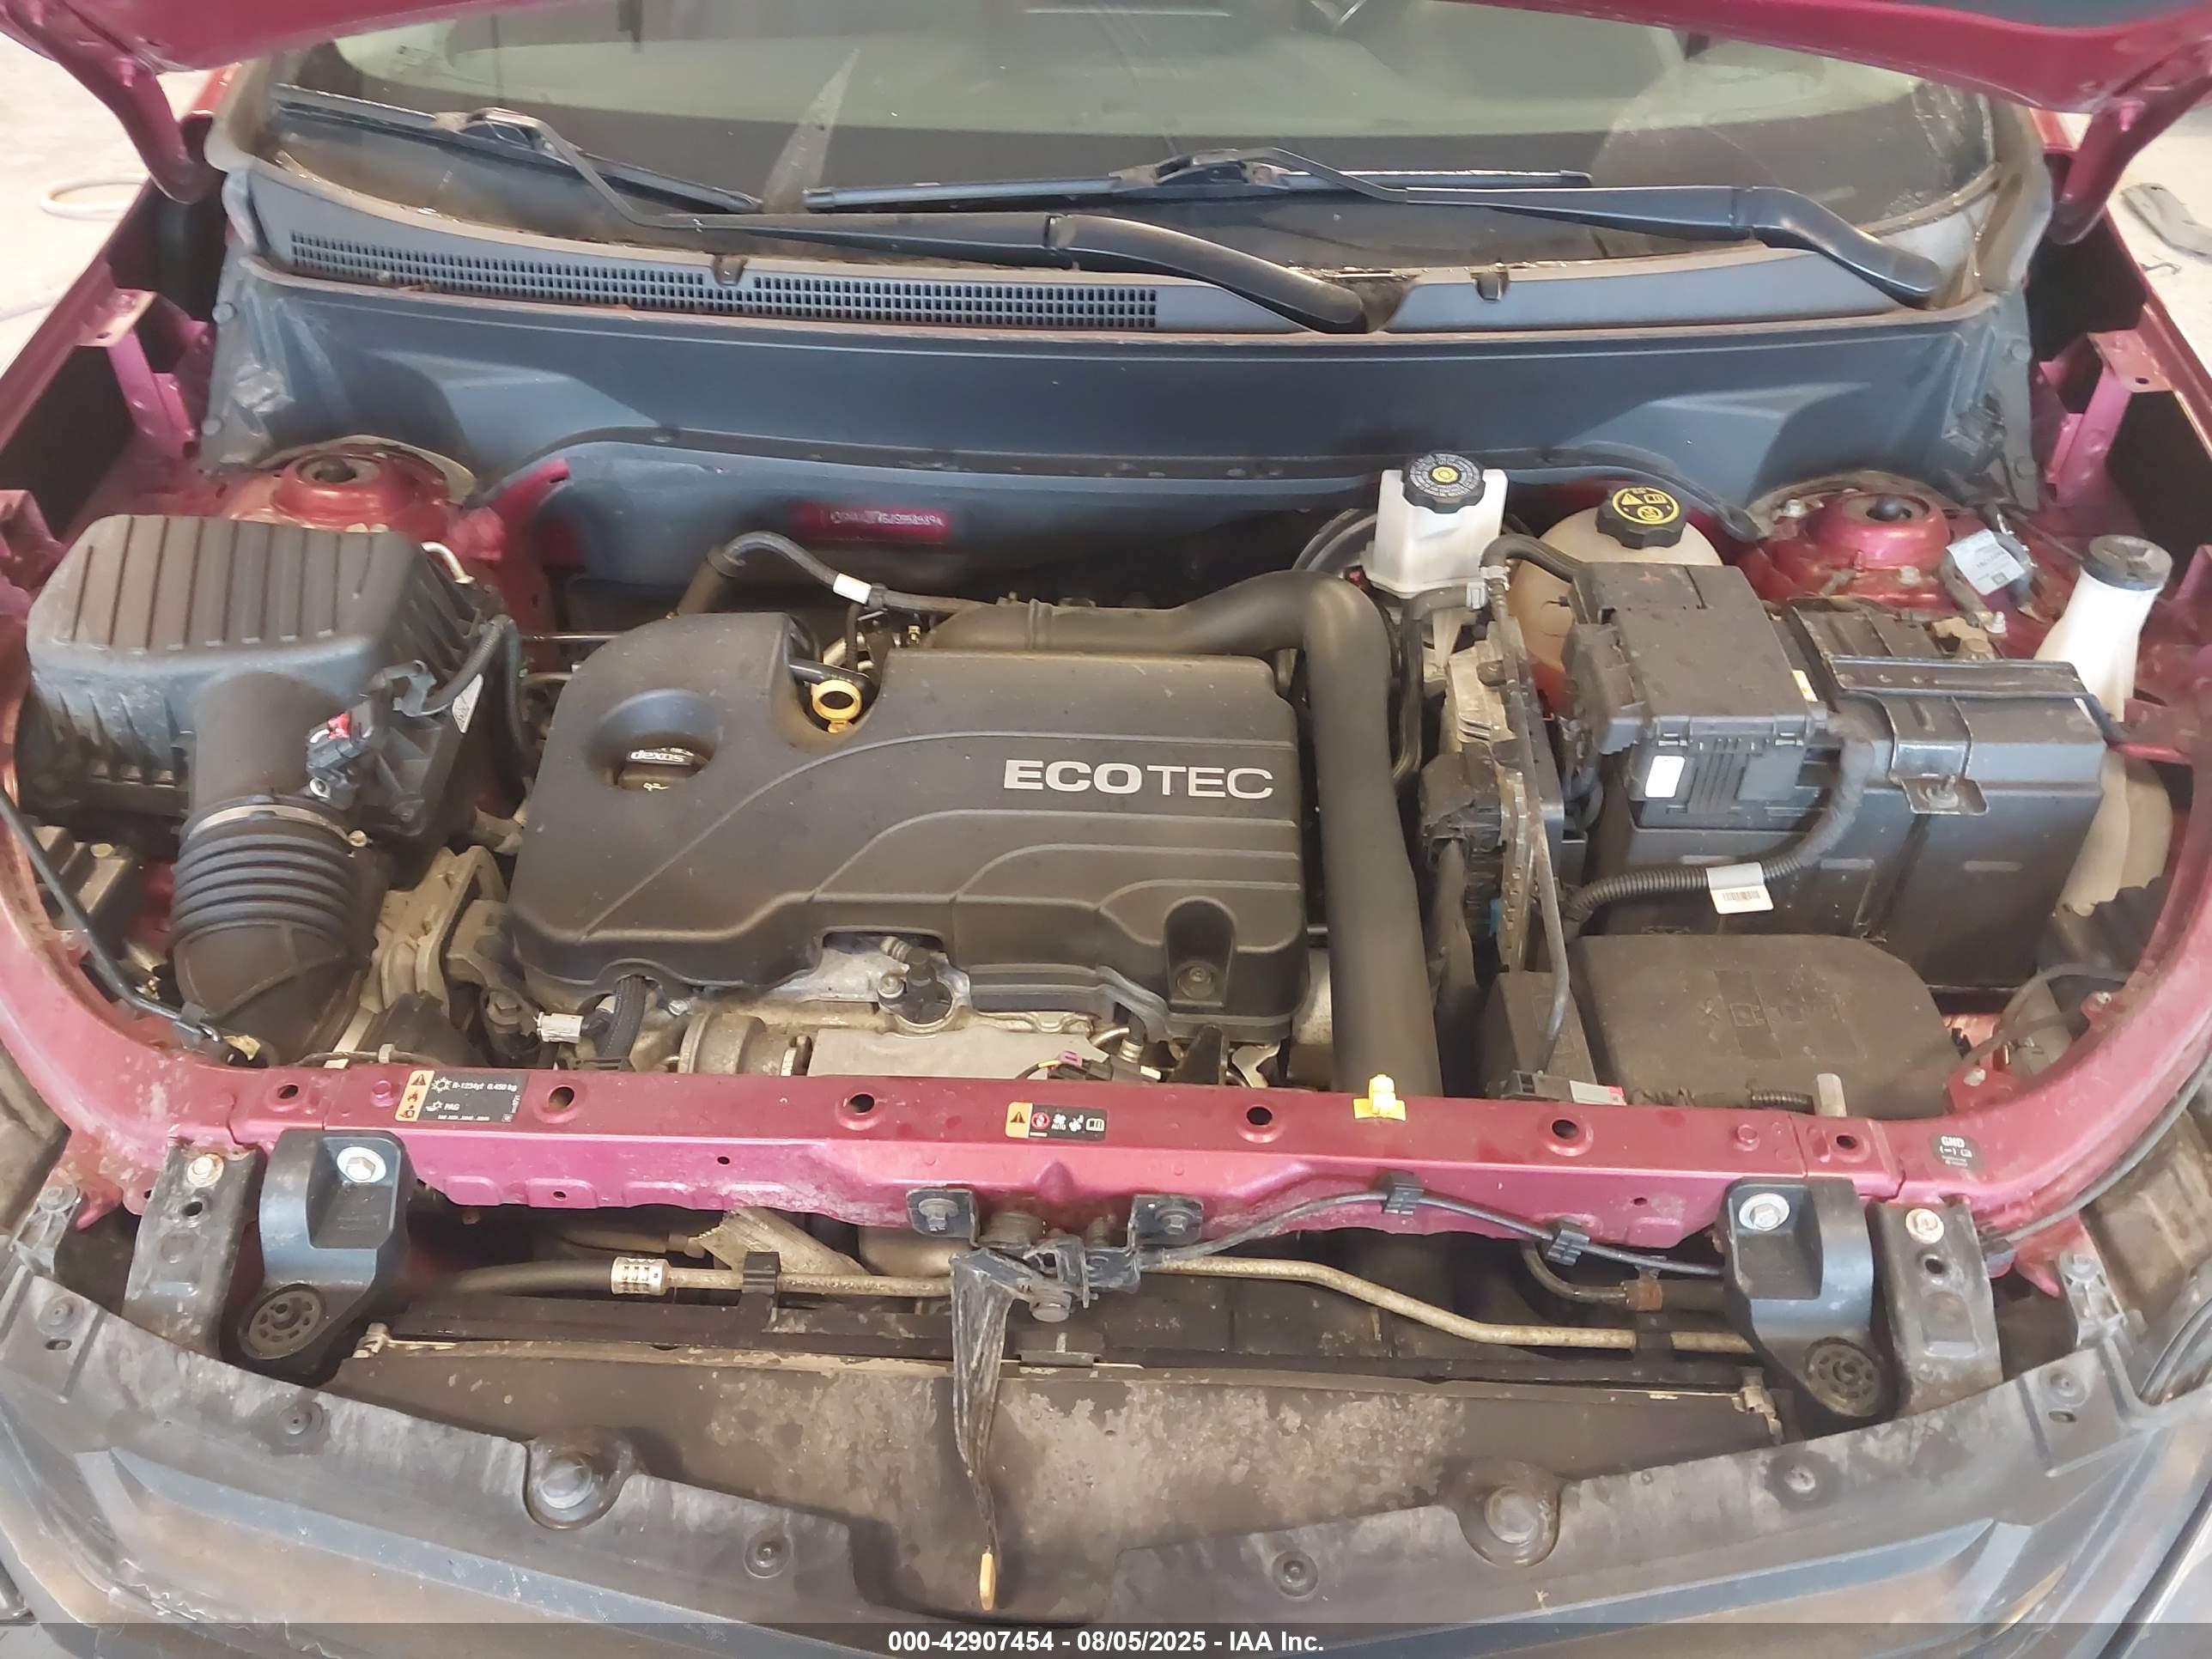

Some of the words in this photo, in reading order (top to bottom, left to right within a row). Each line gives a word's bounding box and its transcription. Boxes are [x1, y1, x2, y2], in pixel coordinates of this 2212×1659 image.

[630, 750, 686, 763] dexos
[1003, 759, 1274, 799] ECOTEC
[444, 1103, 460, 1111] PAG
[1941, 1135, 1966, 1148] GND
